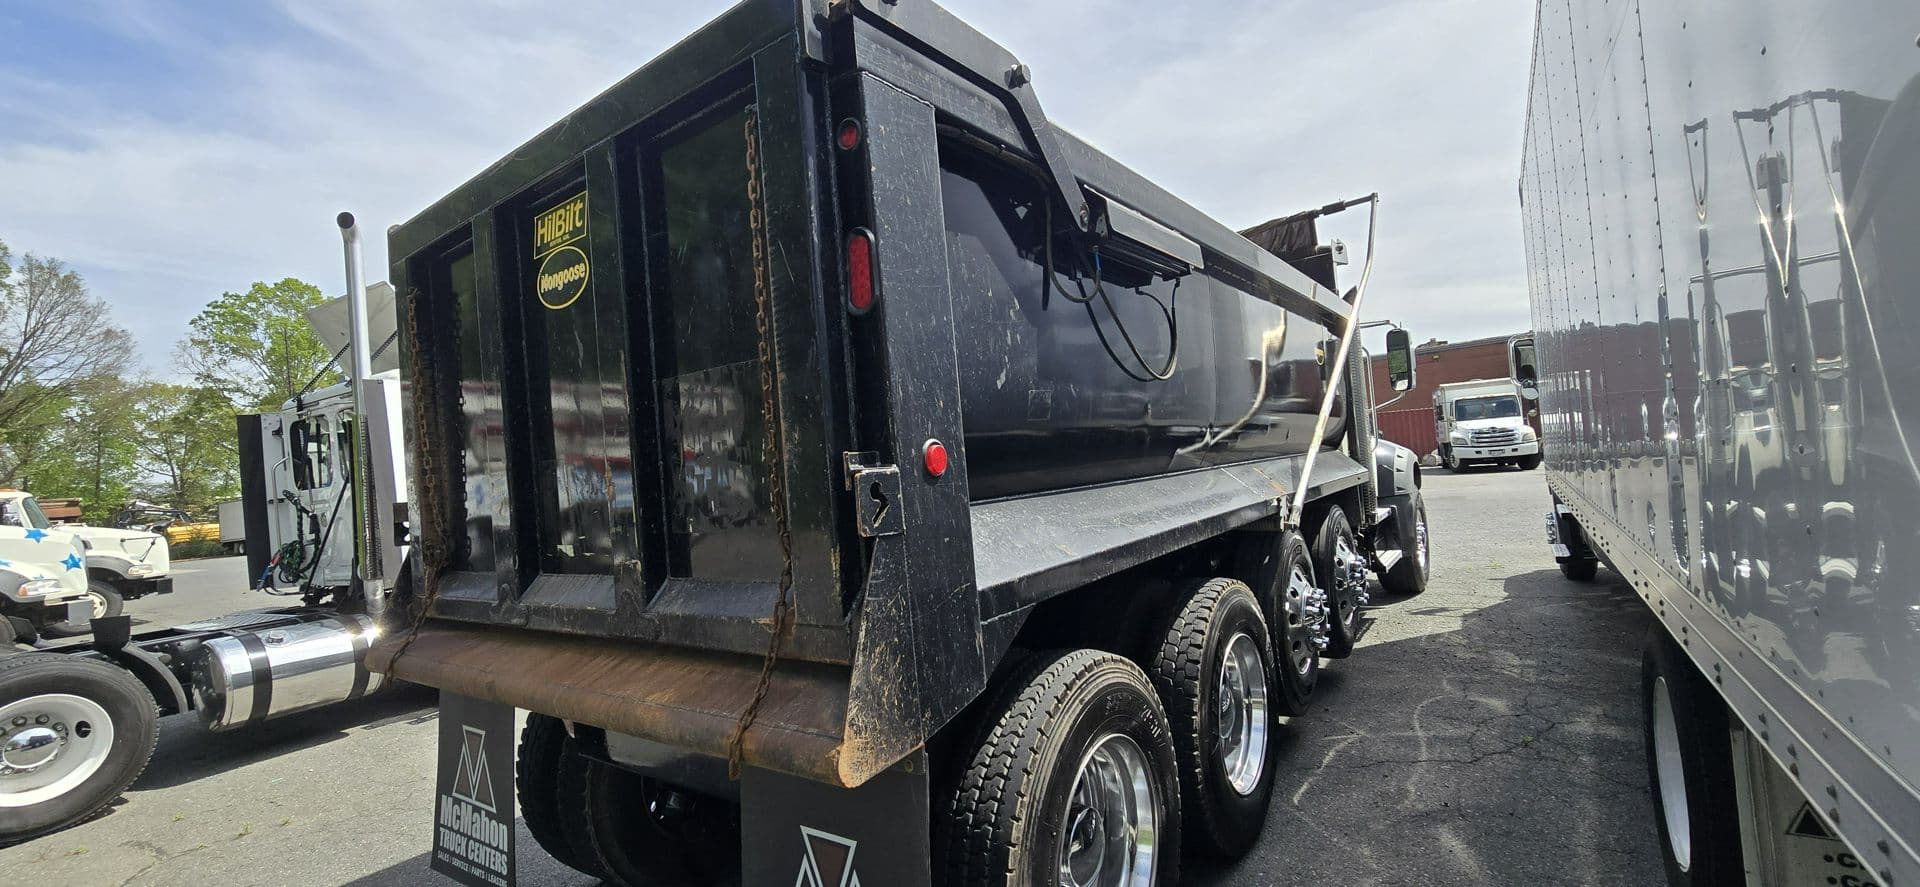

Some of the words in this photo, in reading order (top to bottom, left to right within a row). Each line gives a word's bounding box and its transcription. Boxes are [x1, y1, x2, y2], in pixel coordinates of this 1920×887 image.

[537, 200, 583, 247] HilBilt
[541, 263, 585, 293] Mongoose
[440, 794, 508, 852] McMahon
[437, 850, 449, 863] SALES
[452, 857, 468, 872] SERVICE
[471, 866, 485, 879] PARTS
[440, 827, 467, 857] TRUCK
[468, 839, 508, 876] CENTERS
